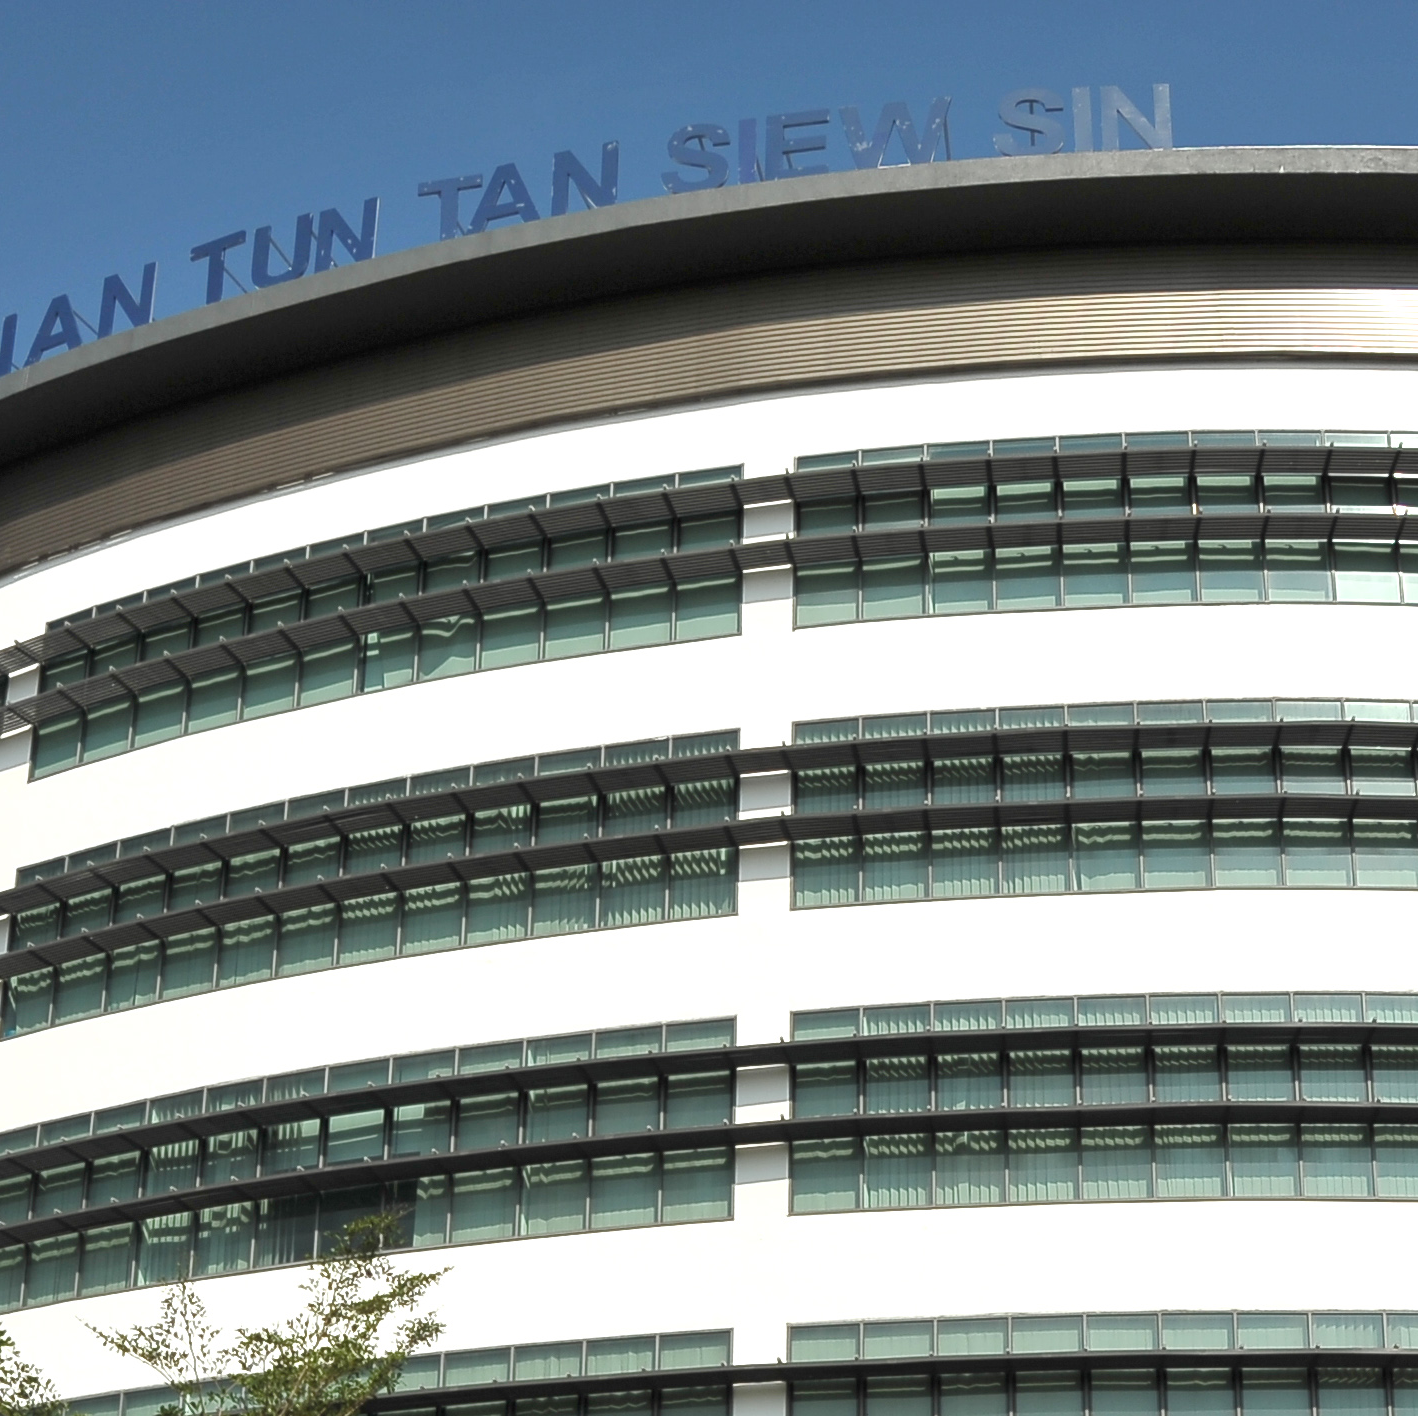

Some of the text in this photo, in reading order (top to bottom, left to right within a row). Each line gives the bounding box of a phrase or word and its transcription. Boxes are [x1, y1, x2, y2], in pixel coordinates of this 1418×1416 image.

[190, 197, 379, 305] TUN
[418, 140, 619, 241] TAN
[662, 96, 950, 194] SIEW
[993, 83, 1173, 156] SIN
